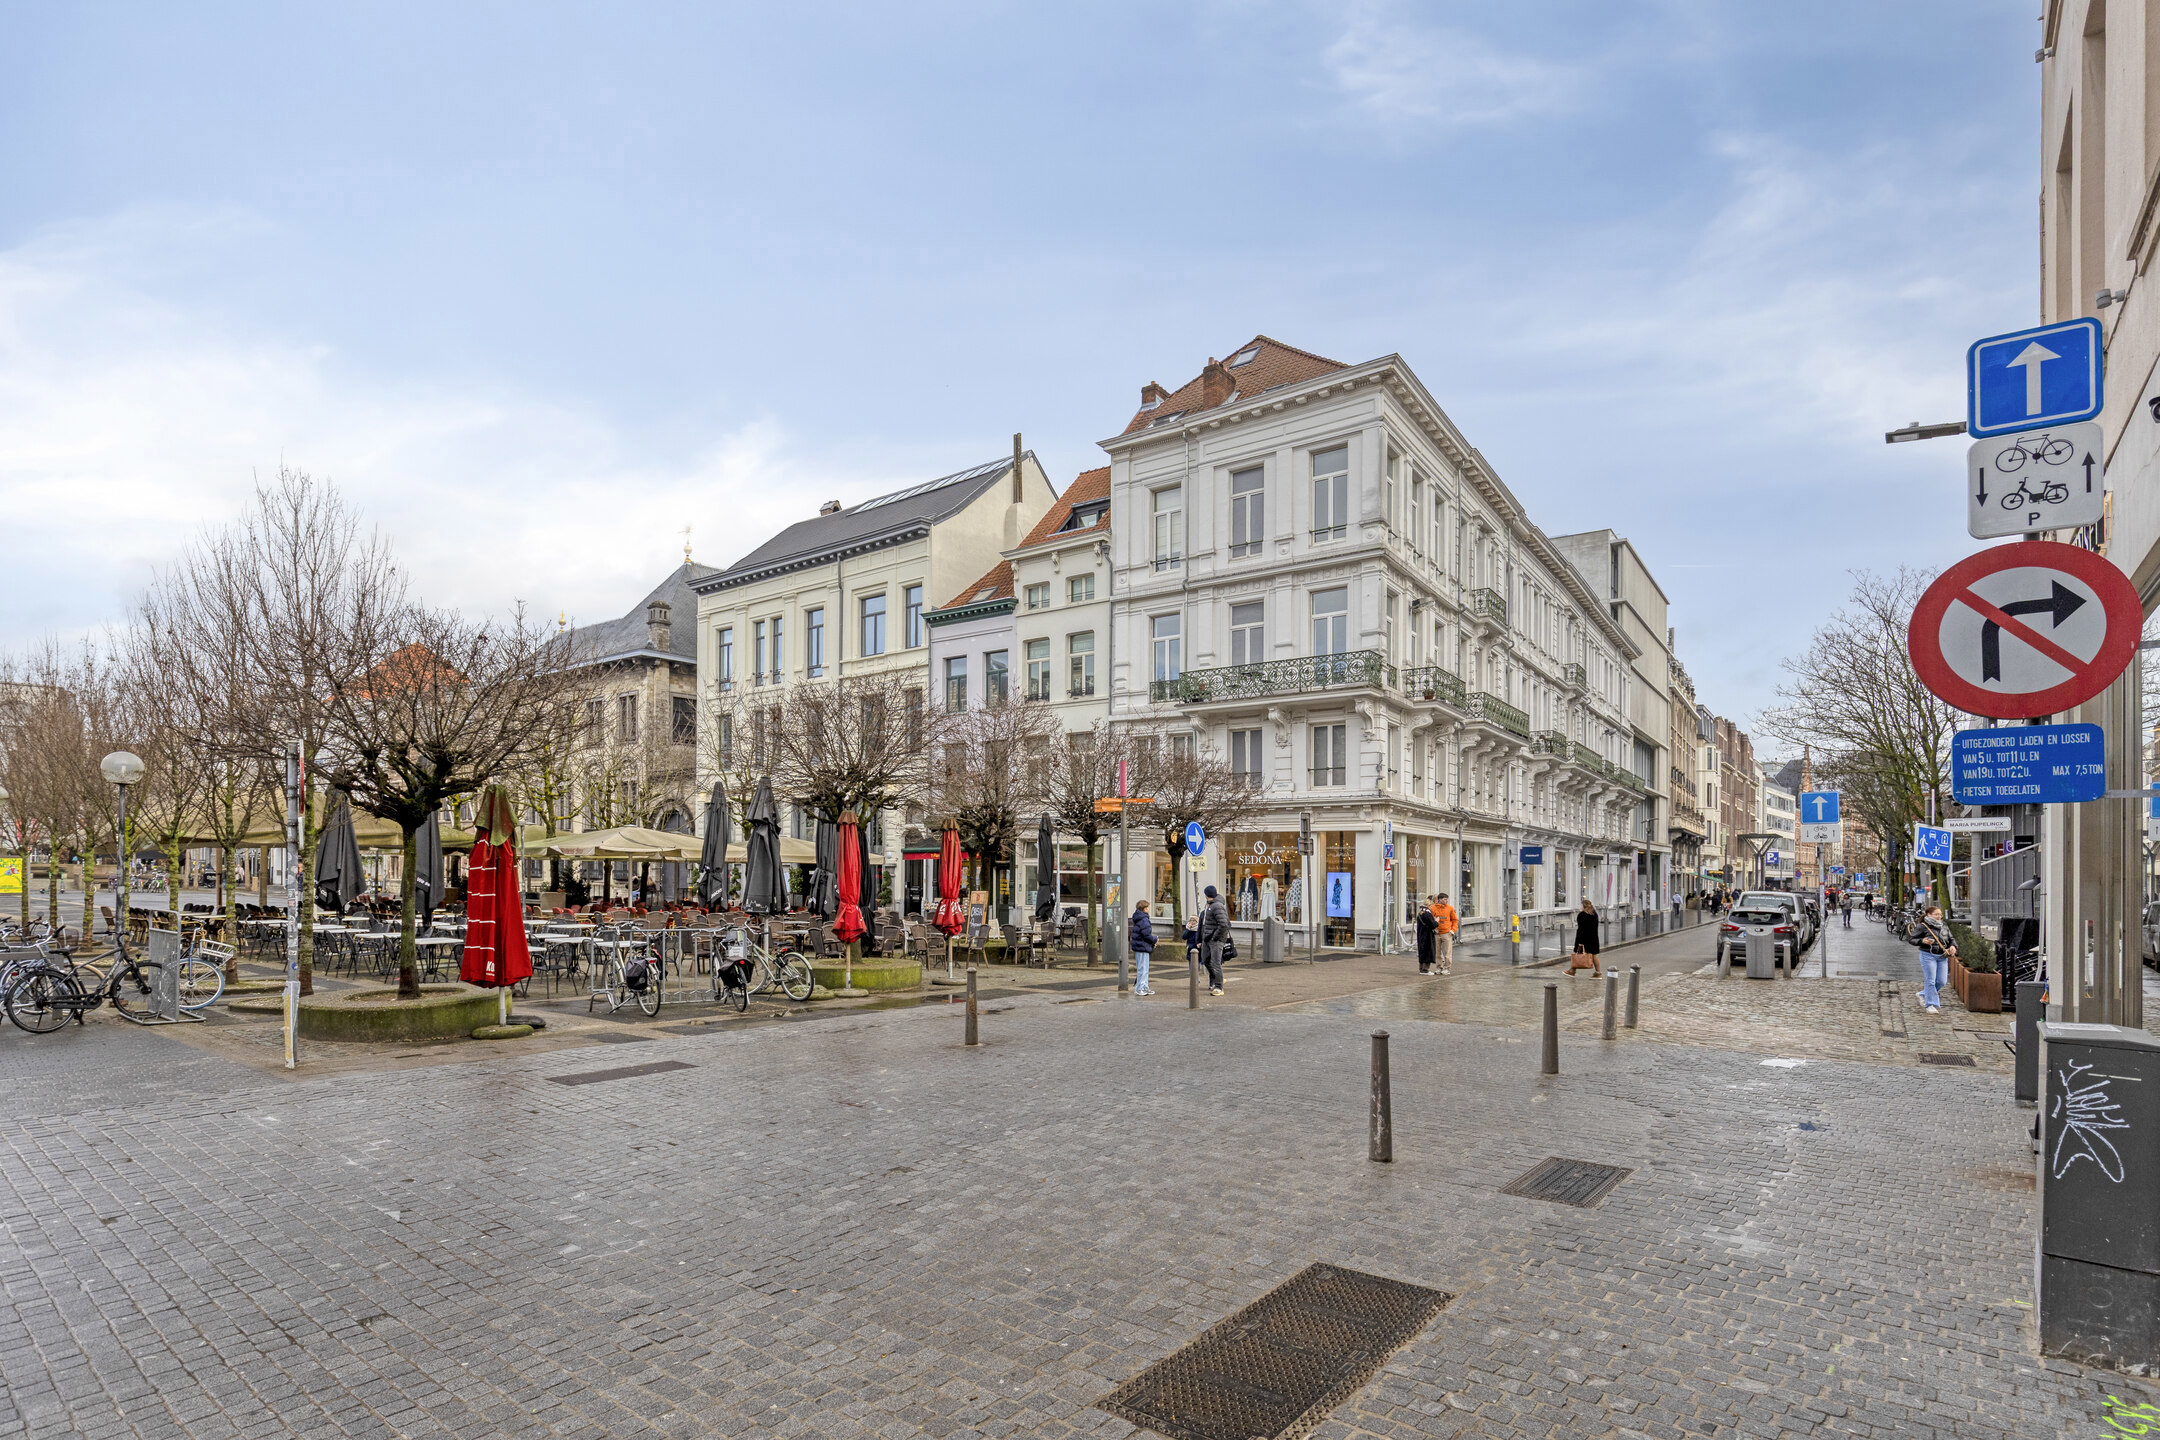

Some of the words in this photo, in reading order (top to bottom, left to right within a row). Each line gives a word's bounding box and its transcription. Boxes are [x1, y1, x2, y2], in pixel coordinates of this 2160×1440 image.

[2028, 512, 2041, 526] P
[1962, 737, 2016, 749] UITGEZONDERD
[2019, 735, 2044, 747] LADEN
[2047, 734, 2058, 745] EN
[2061, 732, 2090, 744] LOSSEN
[1962, 753, 1977, 764] VAN
[2029, 751, 2040, 761] EN
[2052, 765, 2070, 776] MAX
[2075, 764, 2088, 777] 7,5
[2088, 763, 2103, 775] TON
[1962, 786, 1992, 797] FIETSEN
[1996, 784, 2041, 796] TOEGELATEN
[1238, 855, 1282, 865] SEDONA
[1409, 858, 1425, 867] SEDONA
